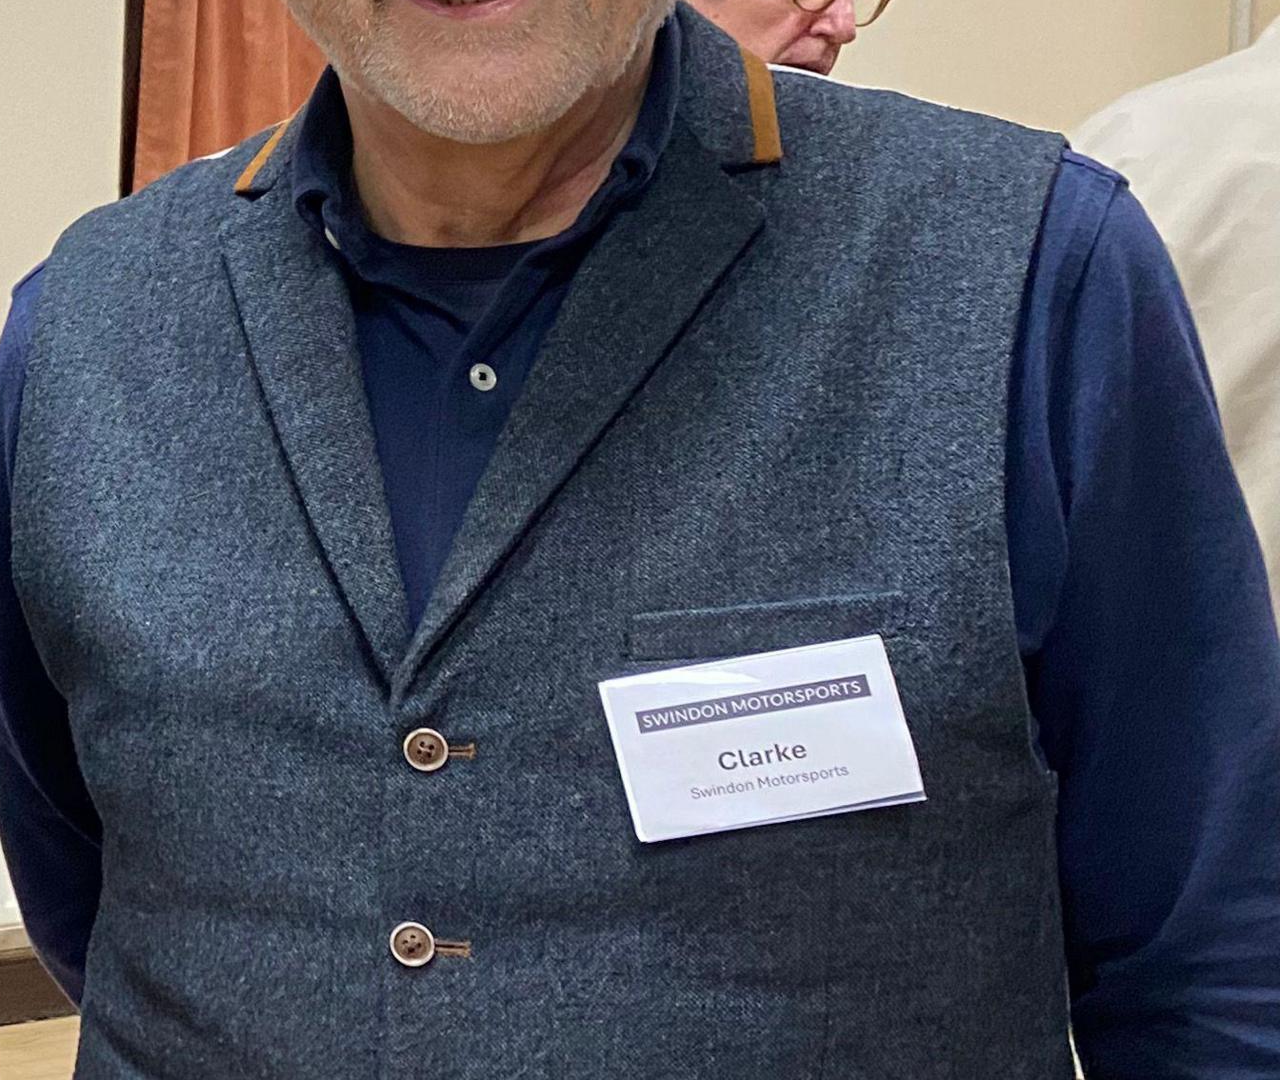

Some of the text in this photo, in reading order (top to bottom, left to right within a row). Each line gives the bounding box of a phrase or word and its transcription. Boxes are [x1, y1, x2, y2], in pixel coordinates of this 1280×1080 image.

[641, 681, 862, 729] SWINDON MOTORSPORTS
[718, 743, 807, 771] Clarke
[690, 765, 850, 800] Swindon Motorsports
